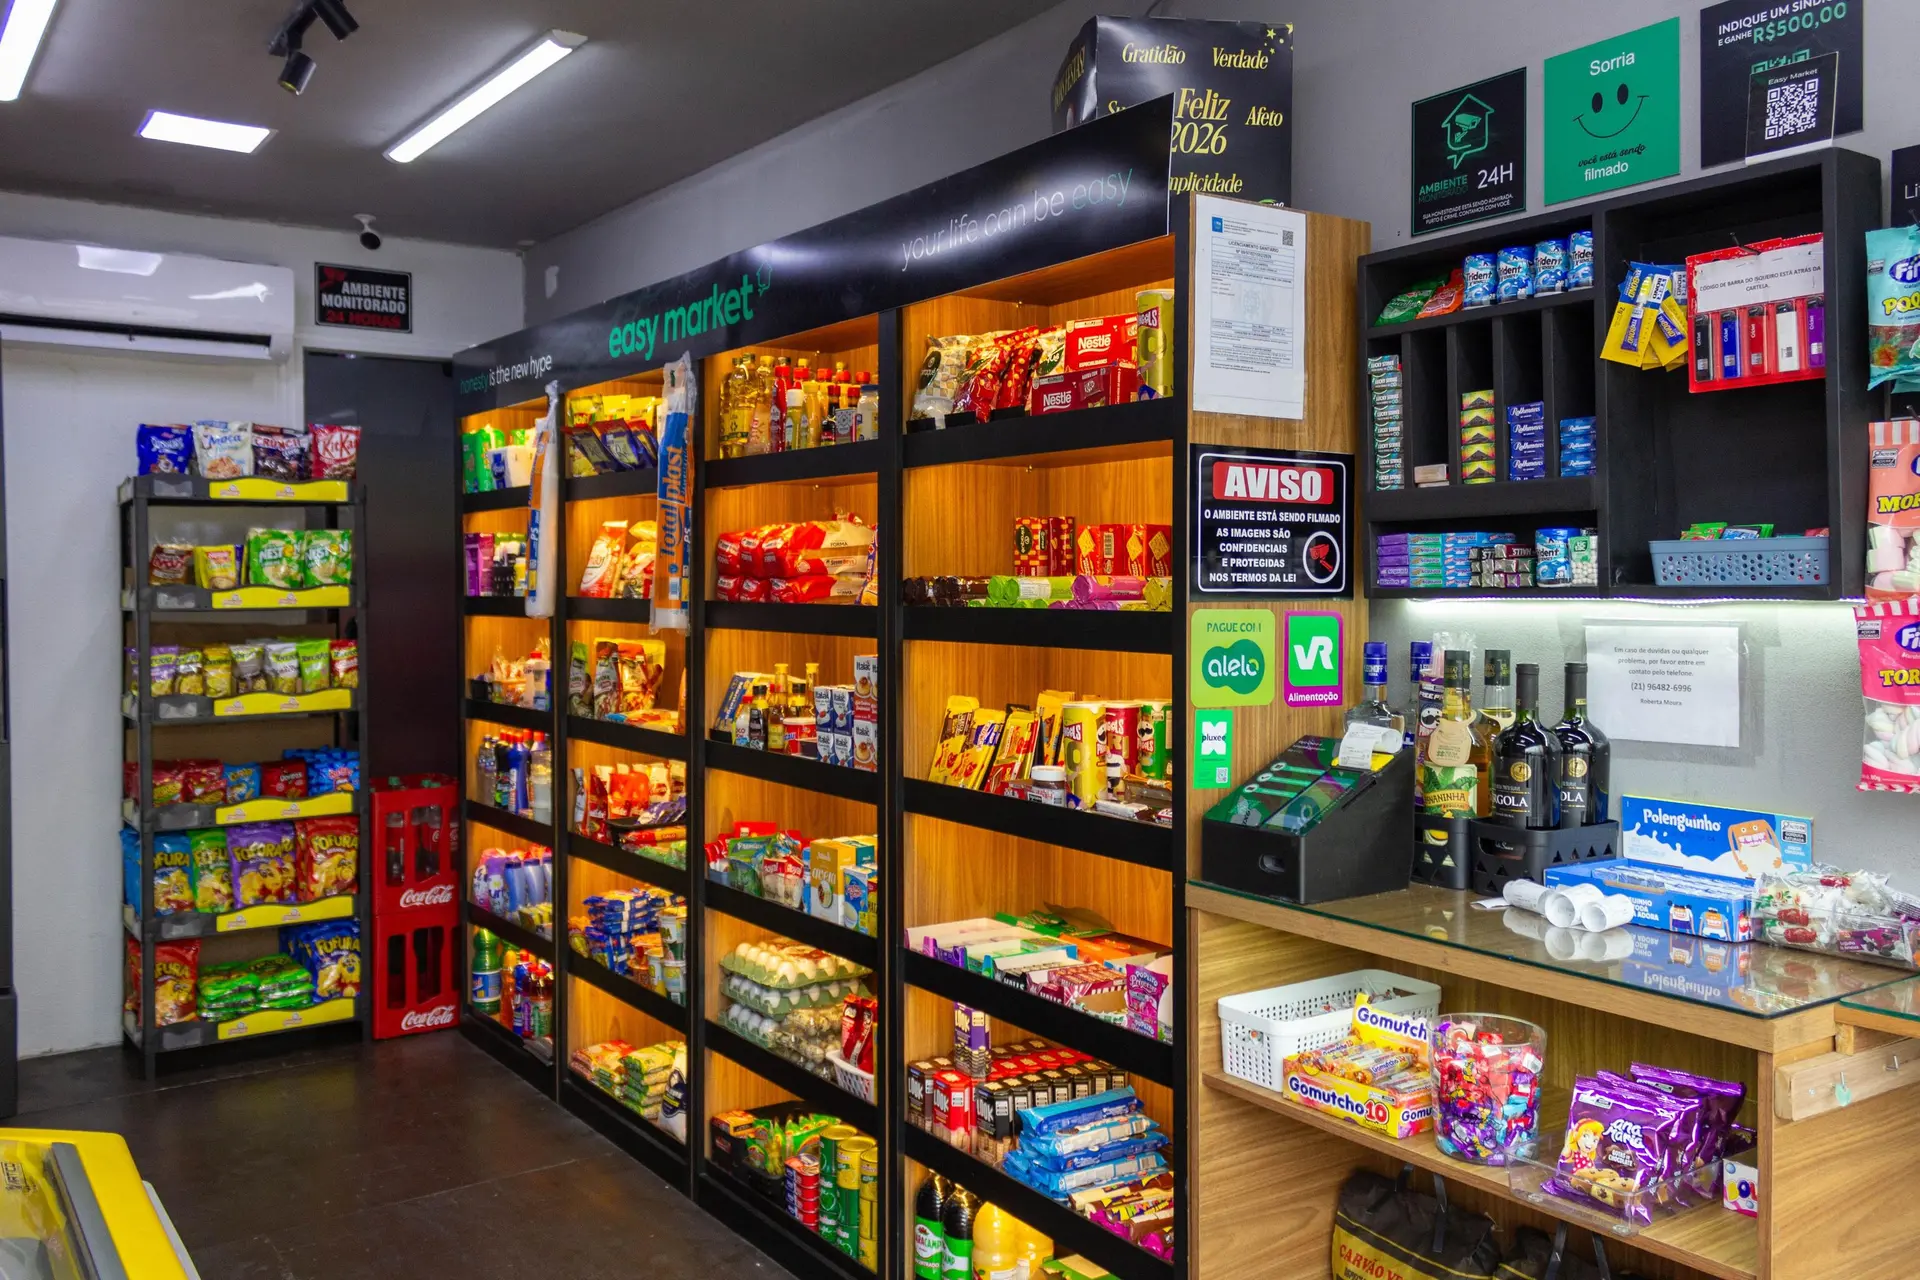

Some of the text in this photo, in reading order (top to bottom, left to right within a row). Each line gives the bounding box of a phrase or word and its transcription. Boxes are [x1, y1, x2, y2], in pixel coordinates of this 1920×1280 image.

[1718, 11, 1768, 36] INDIQUE
[1770, 4, 1790, 19] UM
[1724, 30, 1752, 44] GANHE
[1753, 2, 1848, 44] R$500,00
[1122, 42, 1269, 70] Gratidão Verdade
[1590, 51, 1636, 76] Sorria
[1768, 68, 1818, 86] Easy Market
[1177, 88, 1232, 121] Feliz
[1245, 106, 1284, 127] Afeto
[1170, 122, 1228, 155] 2026
[1478, 162, 1514, 190] 24H
[1584, 160, 1629, 182] filmado
[1418, 174, 1468, 196] AMBIENTE
[902, 168, 1132, 272] your life can be easy
[1465, 270, 1492, 281] Trident
[1700, 282, 1719, 292] CÓDIGO
[1728, 278, 1744, 287] BARRA
[1746, 276, 1754, 284] DO
[1754, 273, 1779, 283] ISQUEIRO
[1780, 268, 1793, 278] ESTÁ
[1794, 266, 1812, 276] ATRÁS
[341, 281, 406, 300] AMBIENTE
[322, 294, 406, 314] MONITORADO
[609, 274, 754, 361] easy market
[1078, 334, 1111, 350] Nestlé
[460, 354, 552, 396] honesty is the new hype
[1043, 390, 1072, 407] Nestlé
[662, 445, 686, 504] plast
[1224, 466, 1322, 502] AVISO
[1204, 509, 1340, 524] O AMBIENTE ESTÁ SENDO FILMADO
[1216, 528, 1290, 538] AS IMAGENS SÃO
[1220, 543, 1288, 554] CONFIDENCIAIS
[1222, 558, 1285, 568] E PROTEGIDAS
[1209, 573, 1296, 582] NOS TERMOS DA LEI
[1207, 622, 1238, 632] PAGUE
[1293, 636, 1334, 670] VR
[1614, 646, 1624, 654] Em
[1681, 648, 1709, 656] qualquer
[1660, 658, 1677, 666] favor
[1208, 654, 1260, 678] alelo
[1652, 669, 1666, 677] pelo
[1288, 692, 1339, 704] Alimentação
[1631, 682, 1692, 692] (21) 96482-6996
[1640, 698, 1662, 706] Roberta
[1202, 734, 1226, 743] pluxee
[1642, 808, 1721, 832] Polenguinho
[400, 884, 454, 908] Coca-Cola
[402, 1005, 456, 1030] Coca-Cola
[1356, 1006, 1428, 1040] Gomutch
[1289, 1077, 1388, 1124] Gomutcho 10
[1401, 1106, 1432, 1123] Gomu
[1340, 1244, 1385, 1277] CARVÃO
